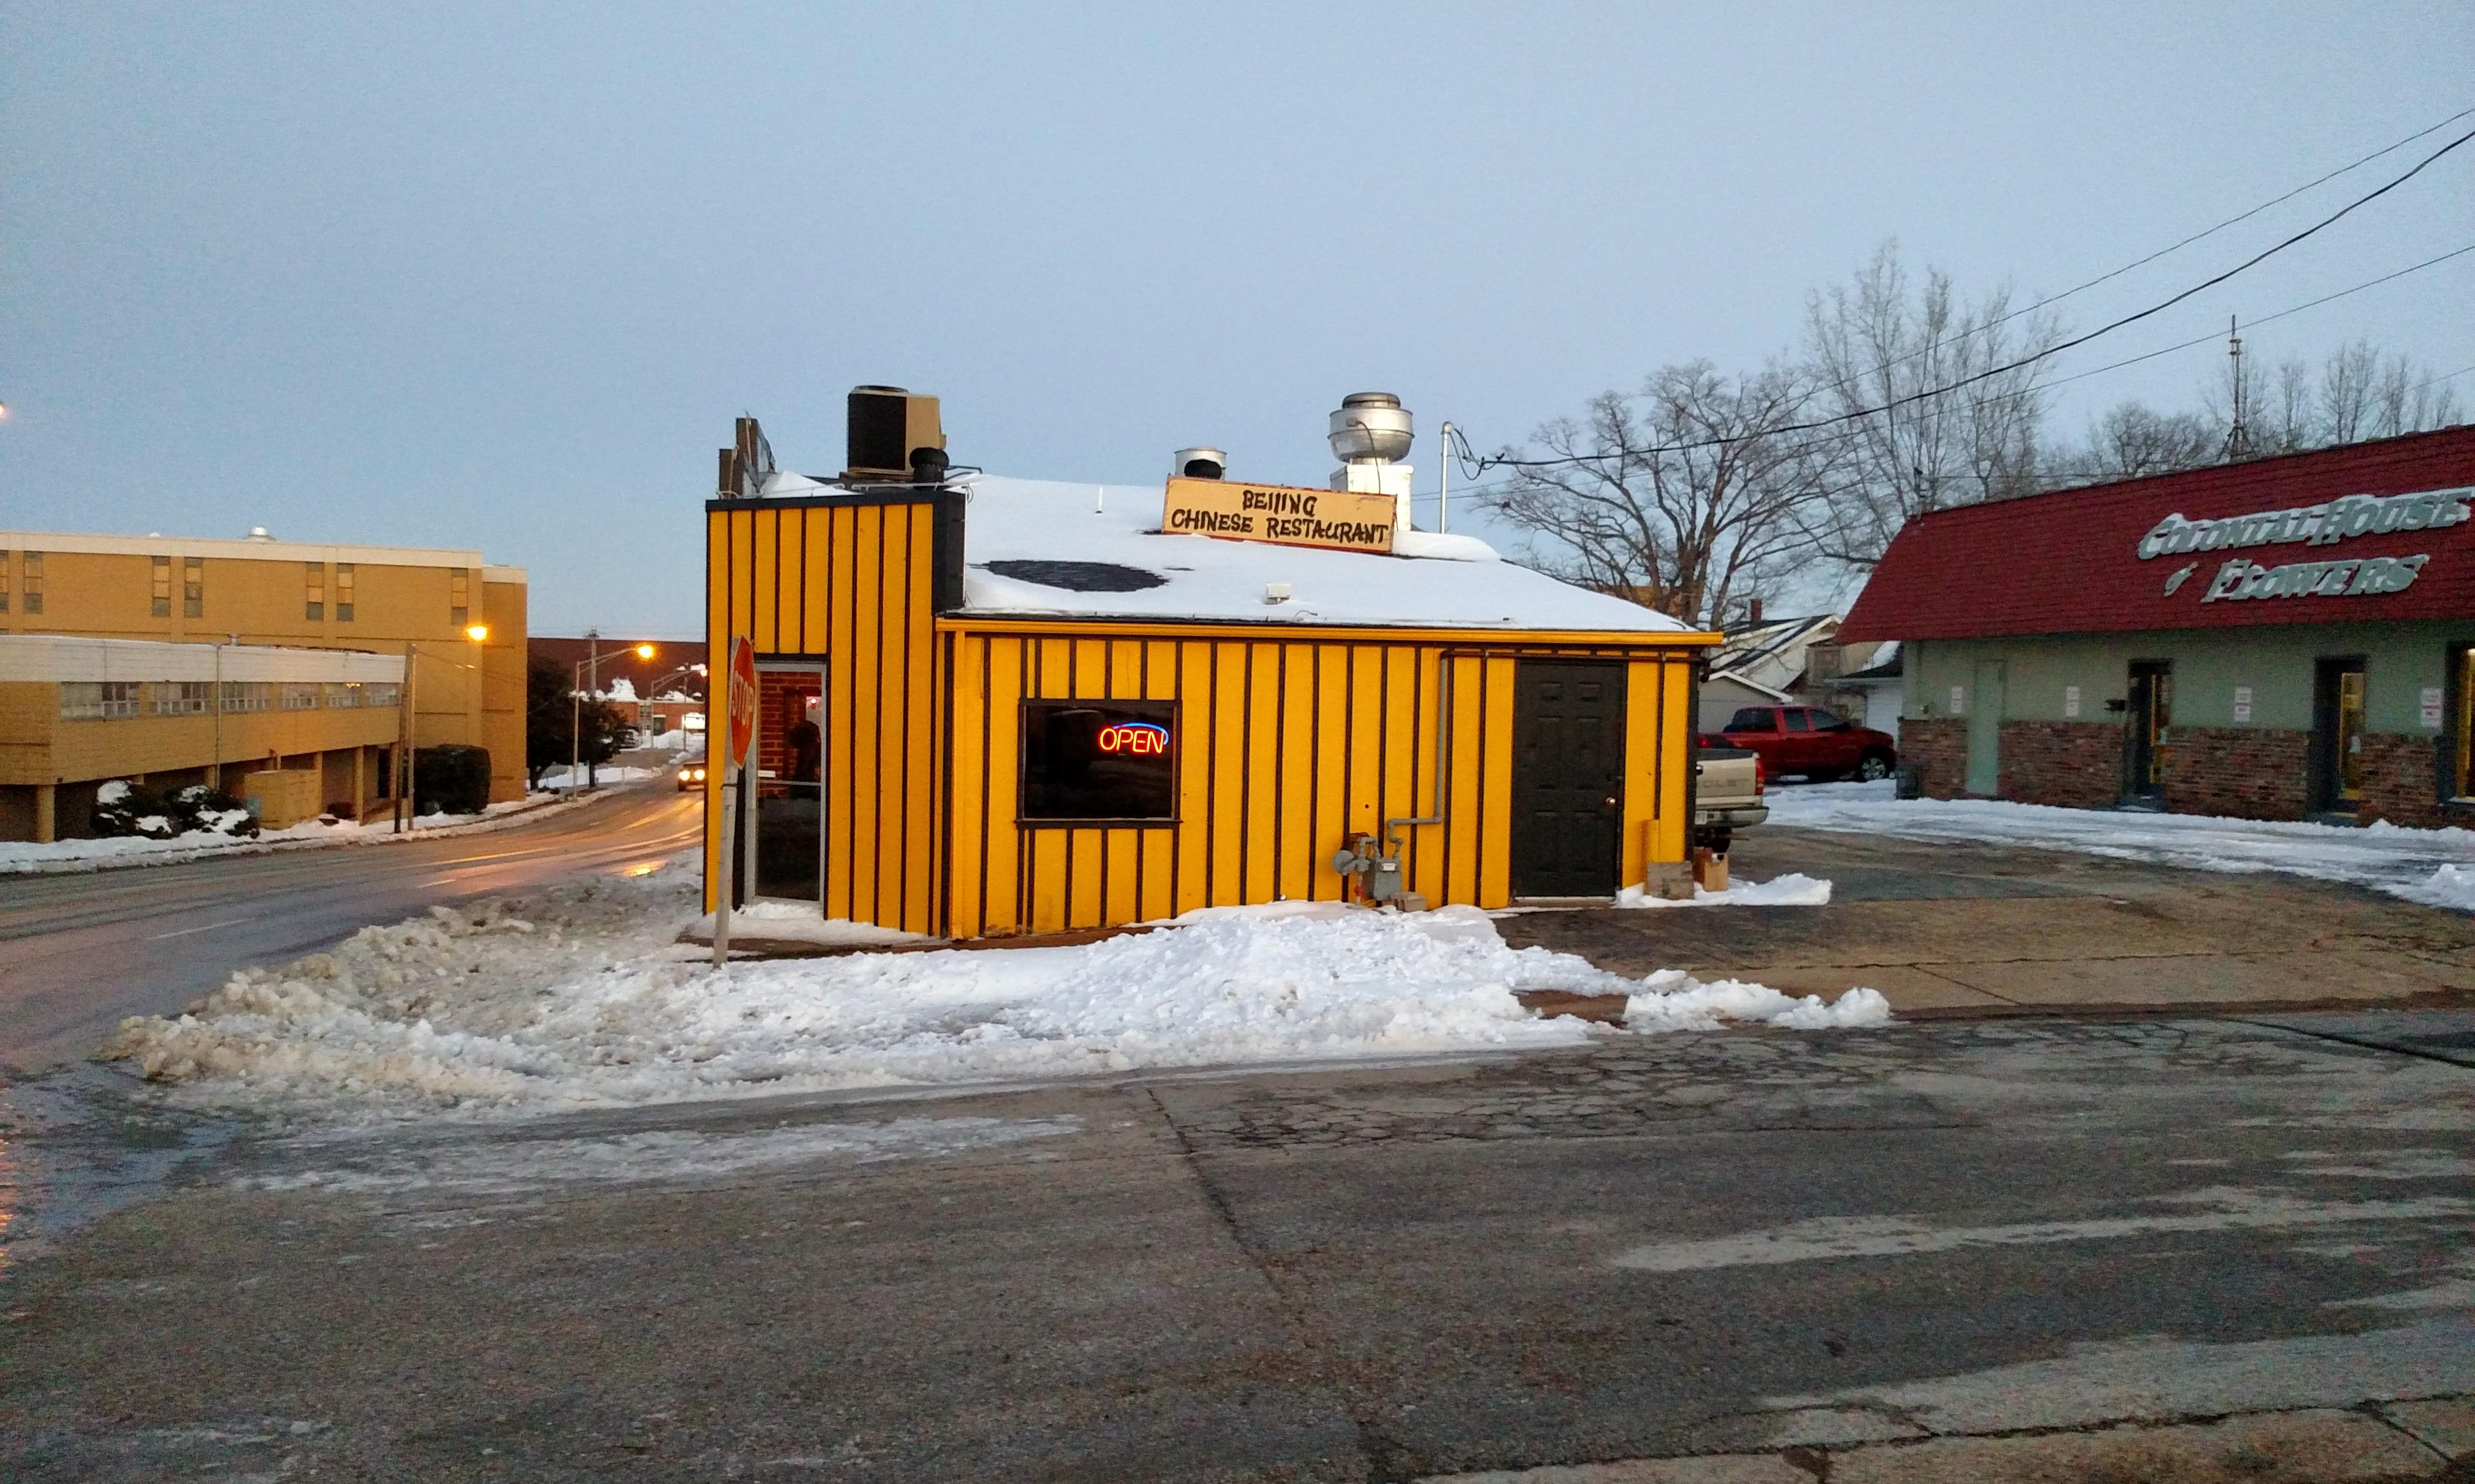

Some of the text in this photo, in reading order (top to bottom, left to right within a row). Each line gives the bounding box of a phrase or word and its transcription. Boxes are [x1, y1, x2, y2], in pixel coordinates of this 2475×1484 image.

[1171, 508, 1388, 544] CHINESE RESTAURANT
[2200, 554, 2430, 603] FLOWERS
[732, 670, 754, 729] STOP
[1099, 728, 1165, 754] OPEN
